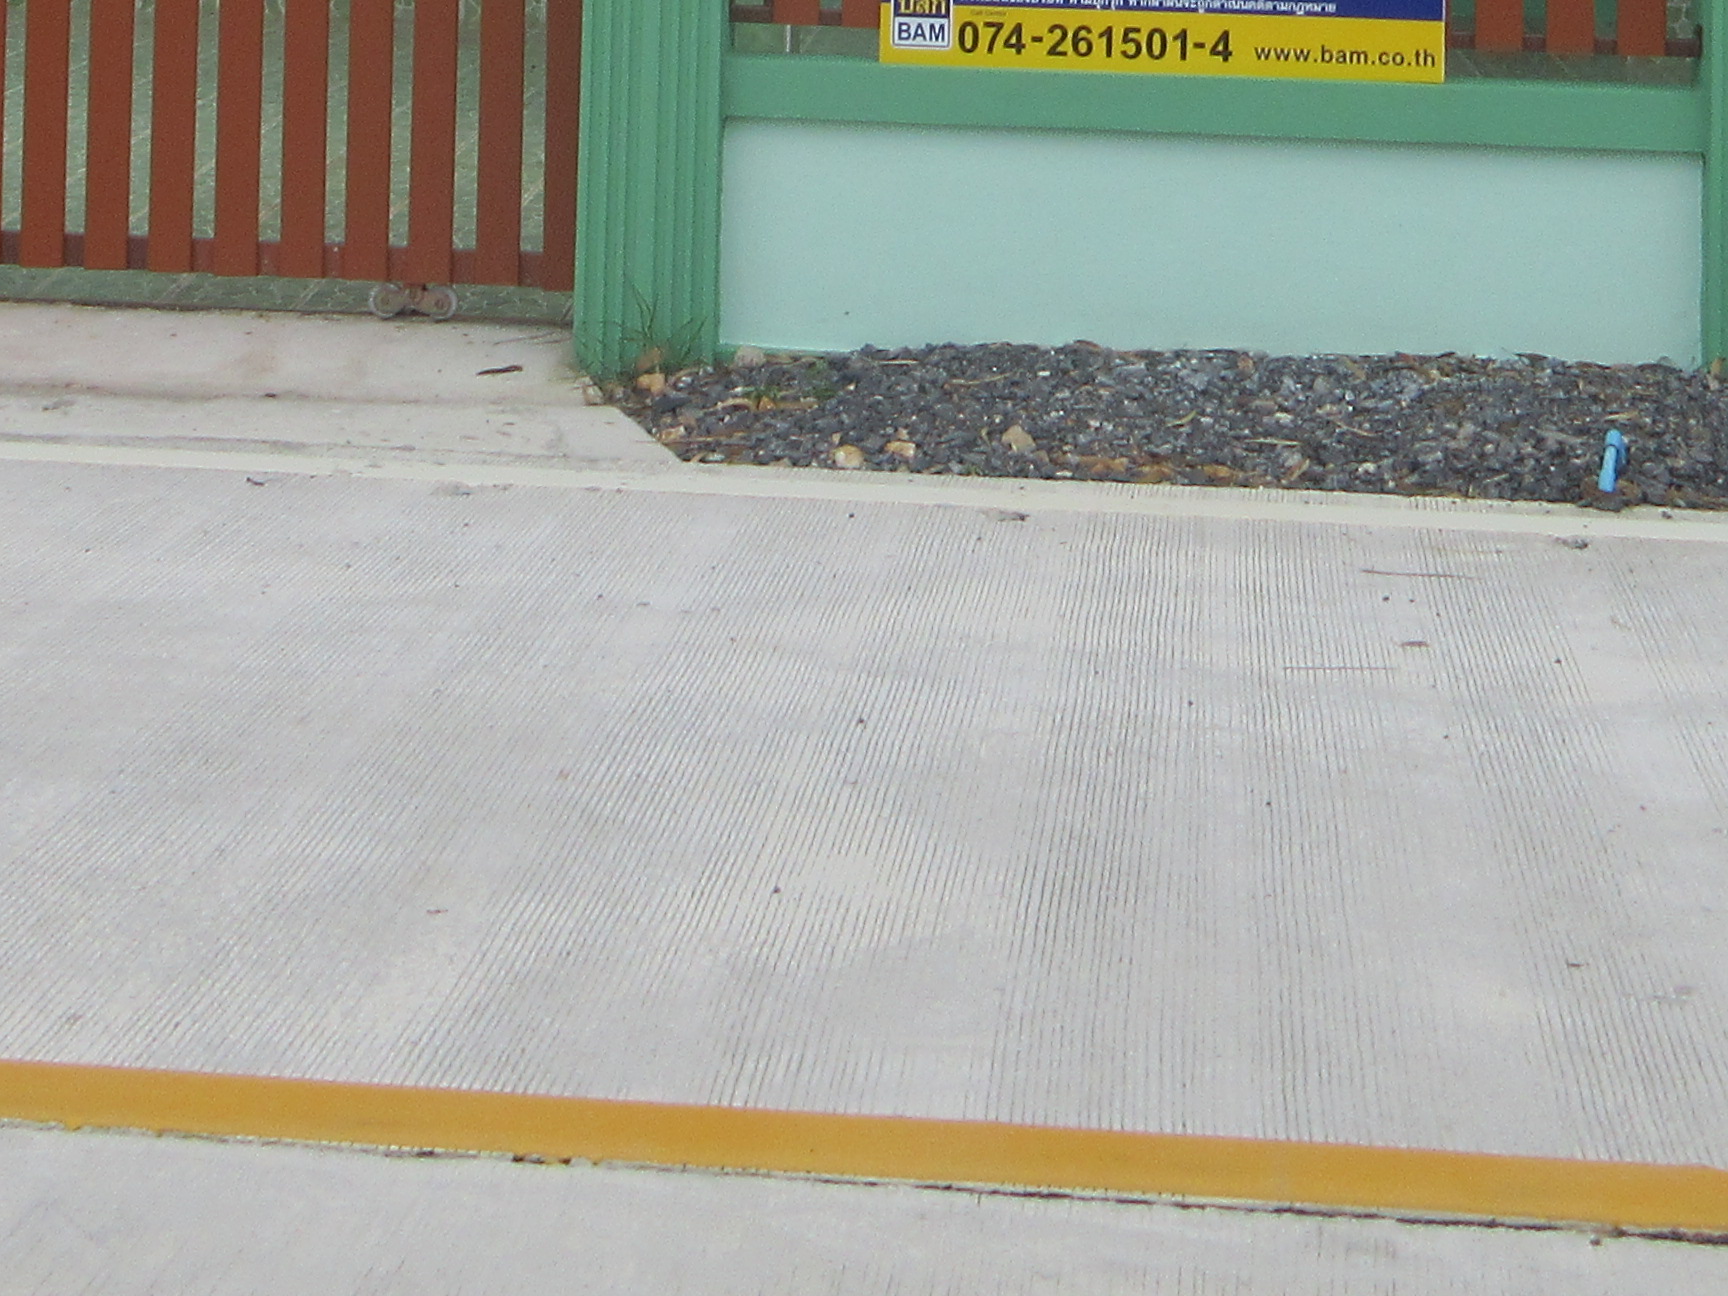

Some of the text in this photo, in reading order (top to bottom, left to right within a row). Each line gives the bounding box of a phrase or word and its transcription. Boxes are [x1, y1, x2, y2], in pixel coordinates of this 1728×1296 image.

[897, 21, 946, 43] BAM
[958, 21, 1437, 68] 074-261501-4 www.bam.co.th
